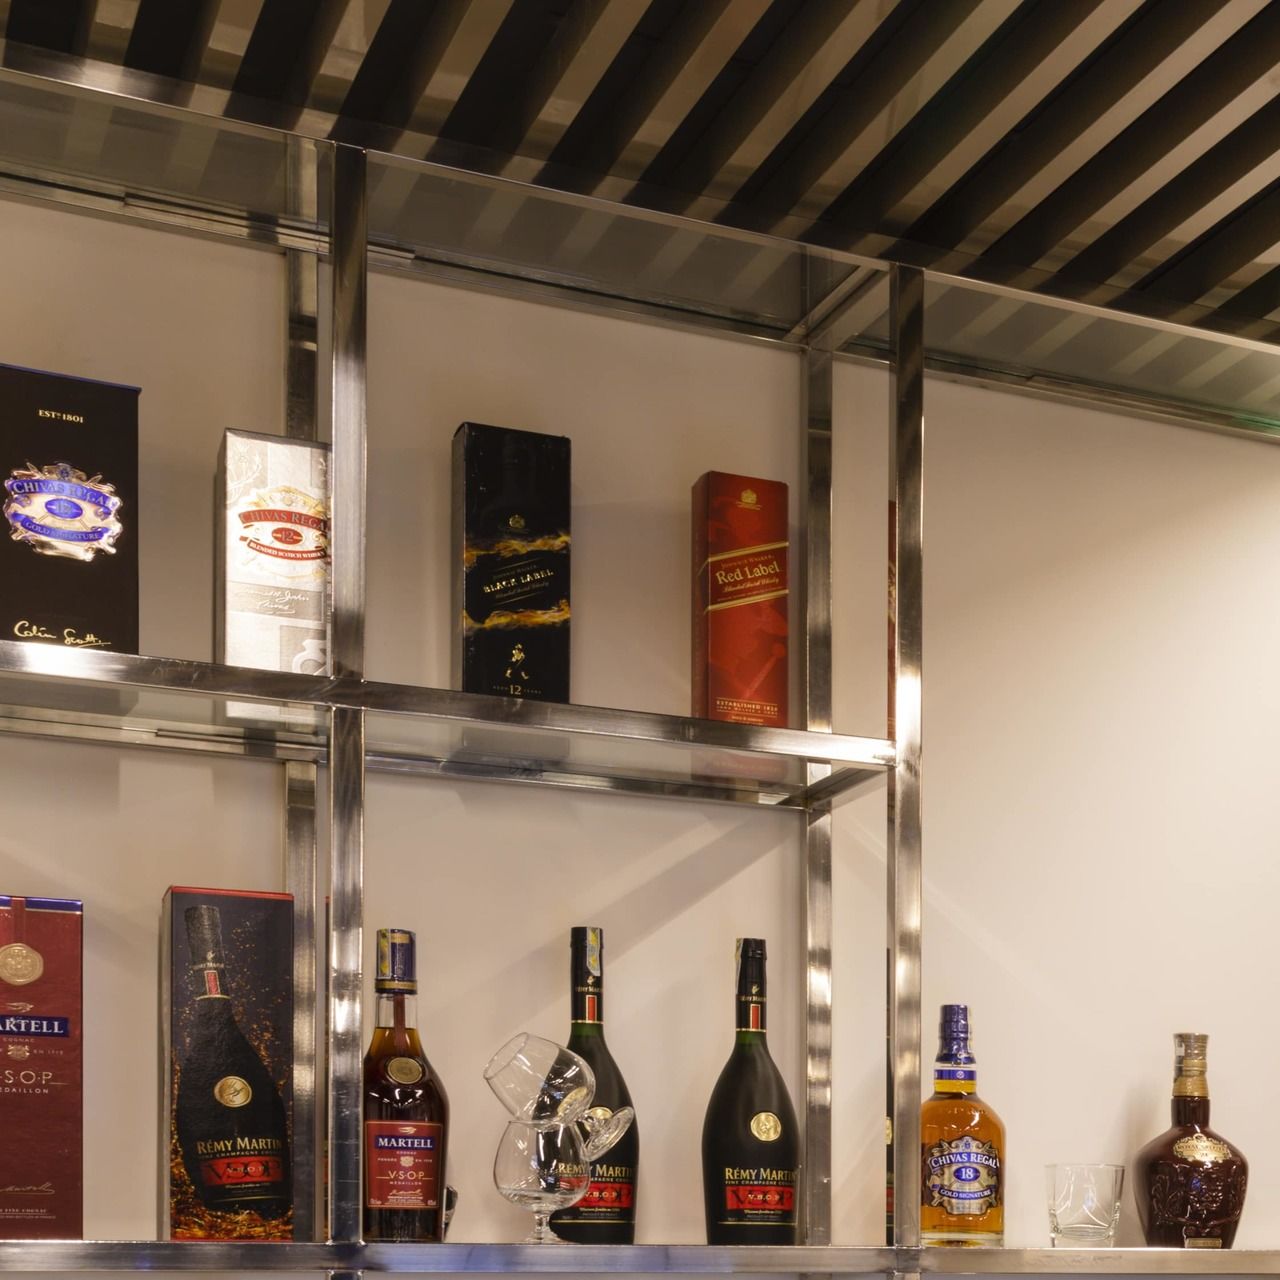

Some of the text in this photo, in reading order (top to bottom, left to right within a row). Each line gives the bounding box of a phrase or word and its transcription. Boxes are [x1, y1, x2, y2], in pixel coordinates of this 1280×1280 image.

[62, 412, 84, 423] 1801
[13, 482, 66, 494] CHIVAS
[240, 509, 288, 523] CHIVAS
[25, 521, 100, 541] GOLD SIGNATURE
[280, 530, 294, 542] 12
[250, 541, 278, 556] BLENDED
[278, 550, 301, 558] SCOTCH
[715, 561, 780, 584] Red Label
[483, 569, 554, 593] BLACK LABEL
[509, 684, 522, 695] 12
[716, 700, 761, 710] ESTABLISHED
[378, 1138, 432, 1148] MARTELL
[931, 1152, 997, 1168] CHIVAS REGAL
[725, 1167, 757, 1180] RÉMY
[961, 1168, 974, 1180] 18
[940, 1189, 991, 1198] GOLD SIGNATURE
